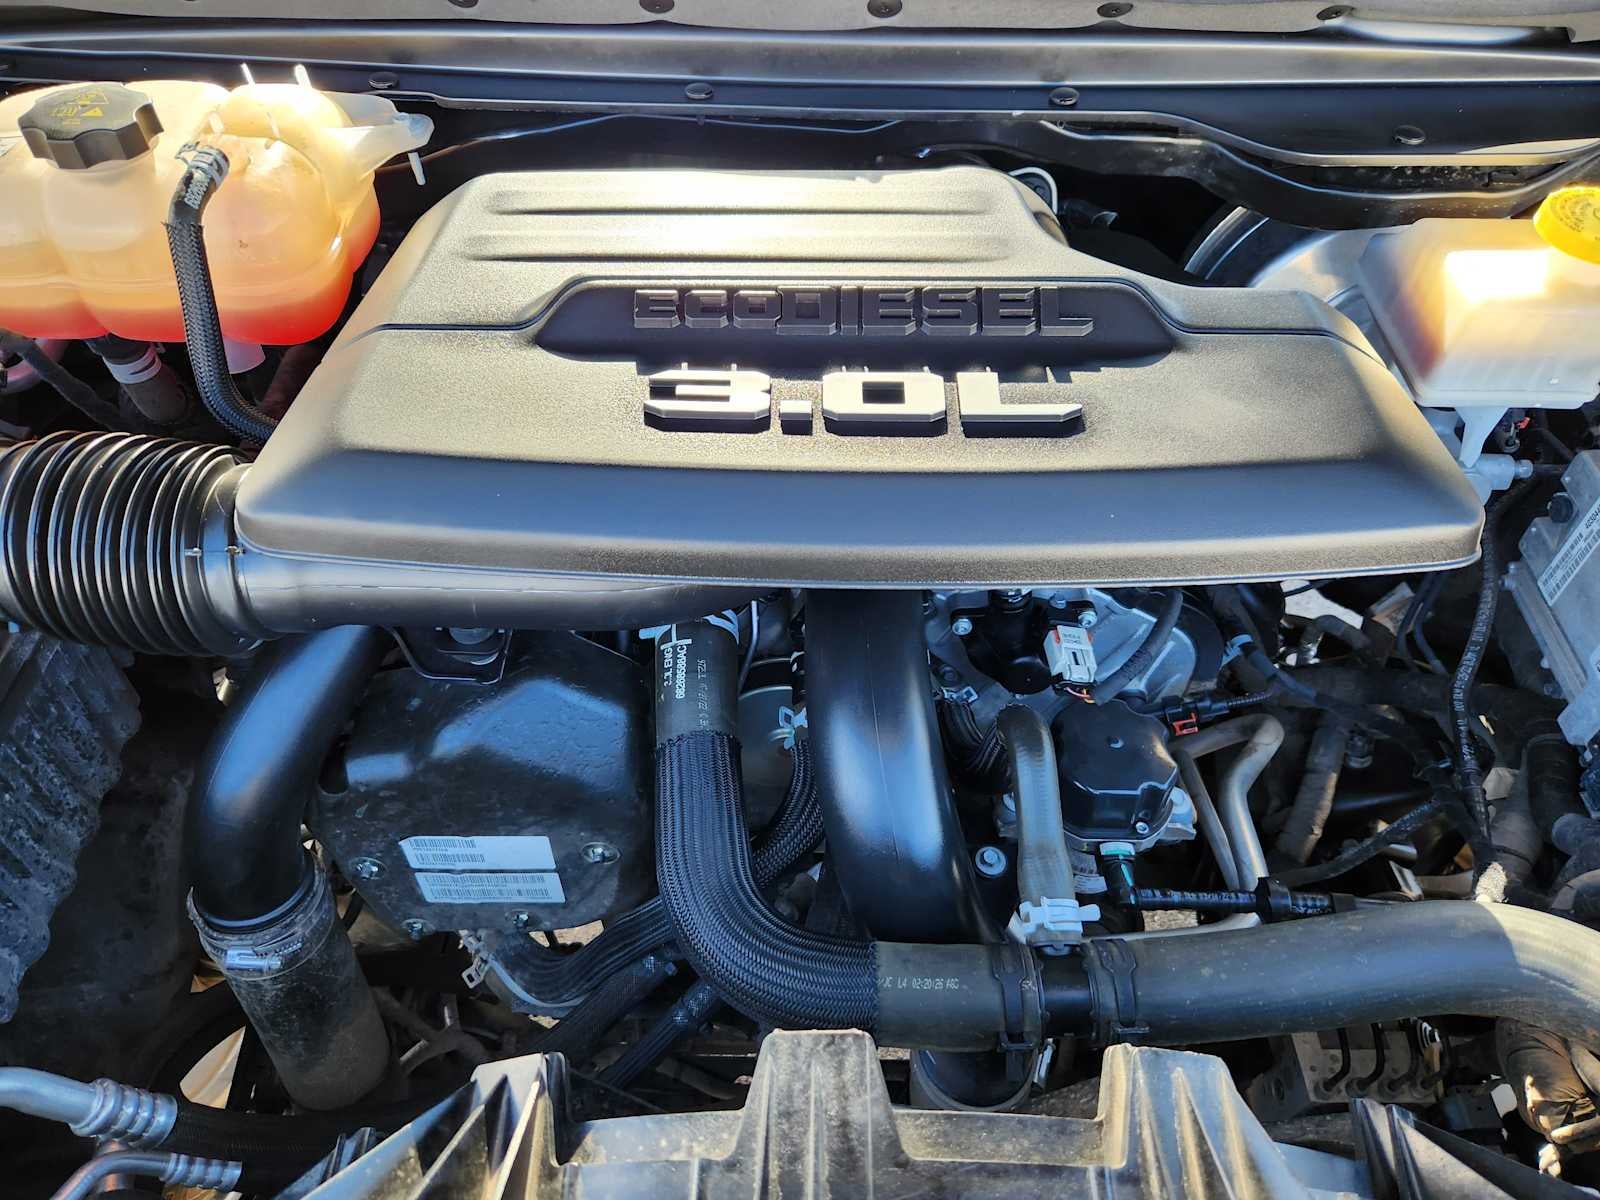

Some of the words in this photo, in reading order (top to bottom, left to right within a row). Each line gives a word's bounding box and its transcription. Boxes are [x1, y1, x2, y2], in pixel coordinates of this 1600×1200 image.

[634, 286, 1095, 337] ECODIESEL
[644, 369, 1084, 423] 3.0L
[664, 647, 673, 668] ENG
